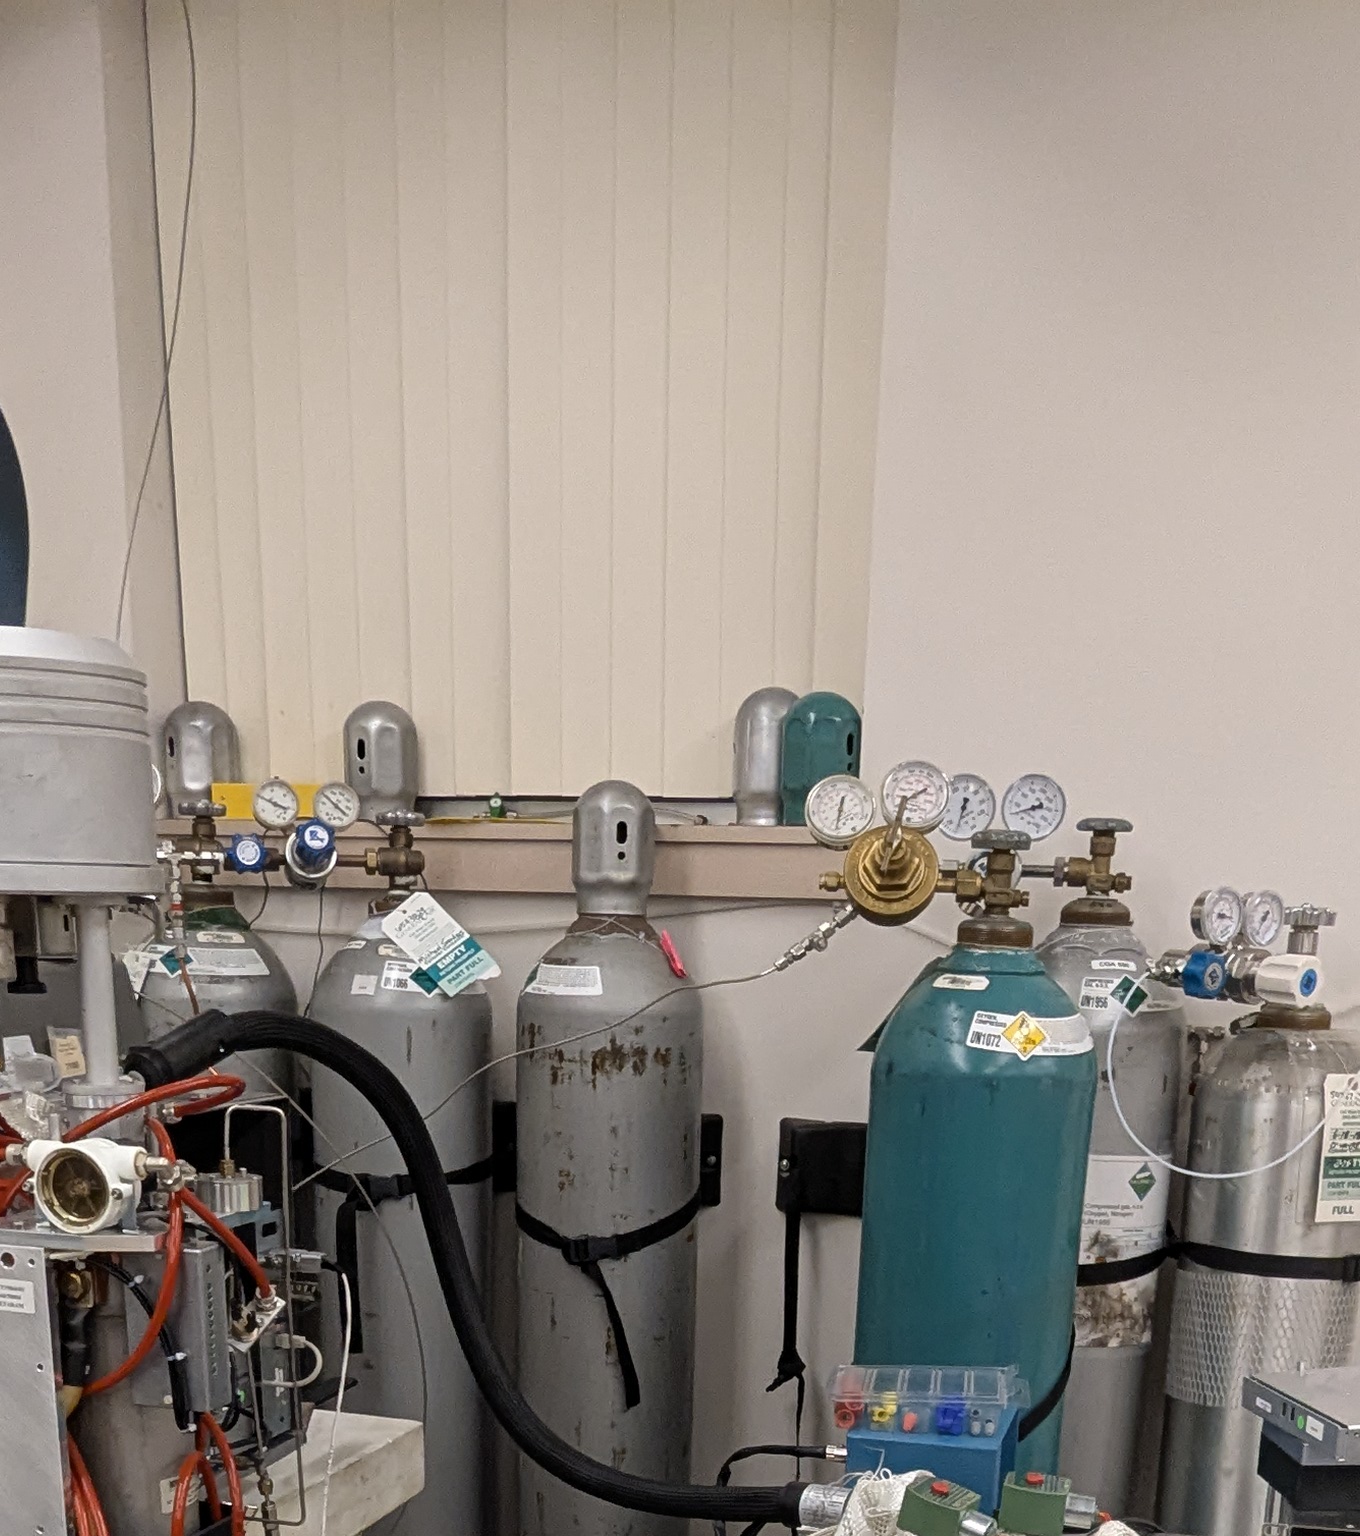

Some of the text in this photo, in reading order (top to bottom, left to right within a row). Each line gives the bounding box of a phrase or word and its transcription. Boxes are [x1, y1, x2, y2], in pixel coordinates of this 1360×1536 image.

[436, 944, 467, 969] EMPTY
[466, 956, 484, 972] FULL
[969, 1030, 1002, 1049] UN1072
[1332, 1206, 1355, 1215] FULL
